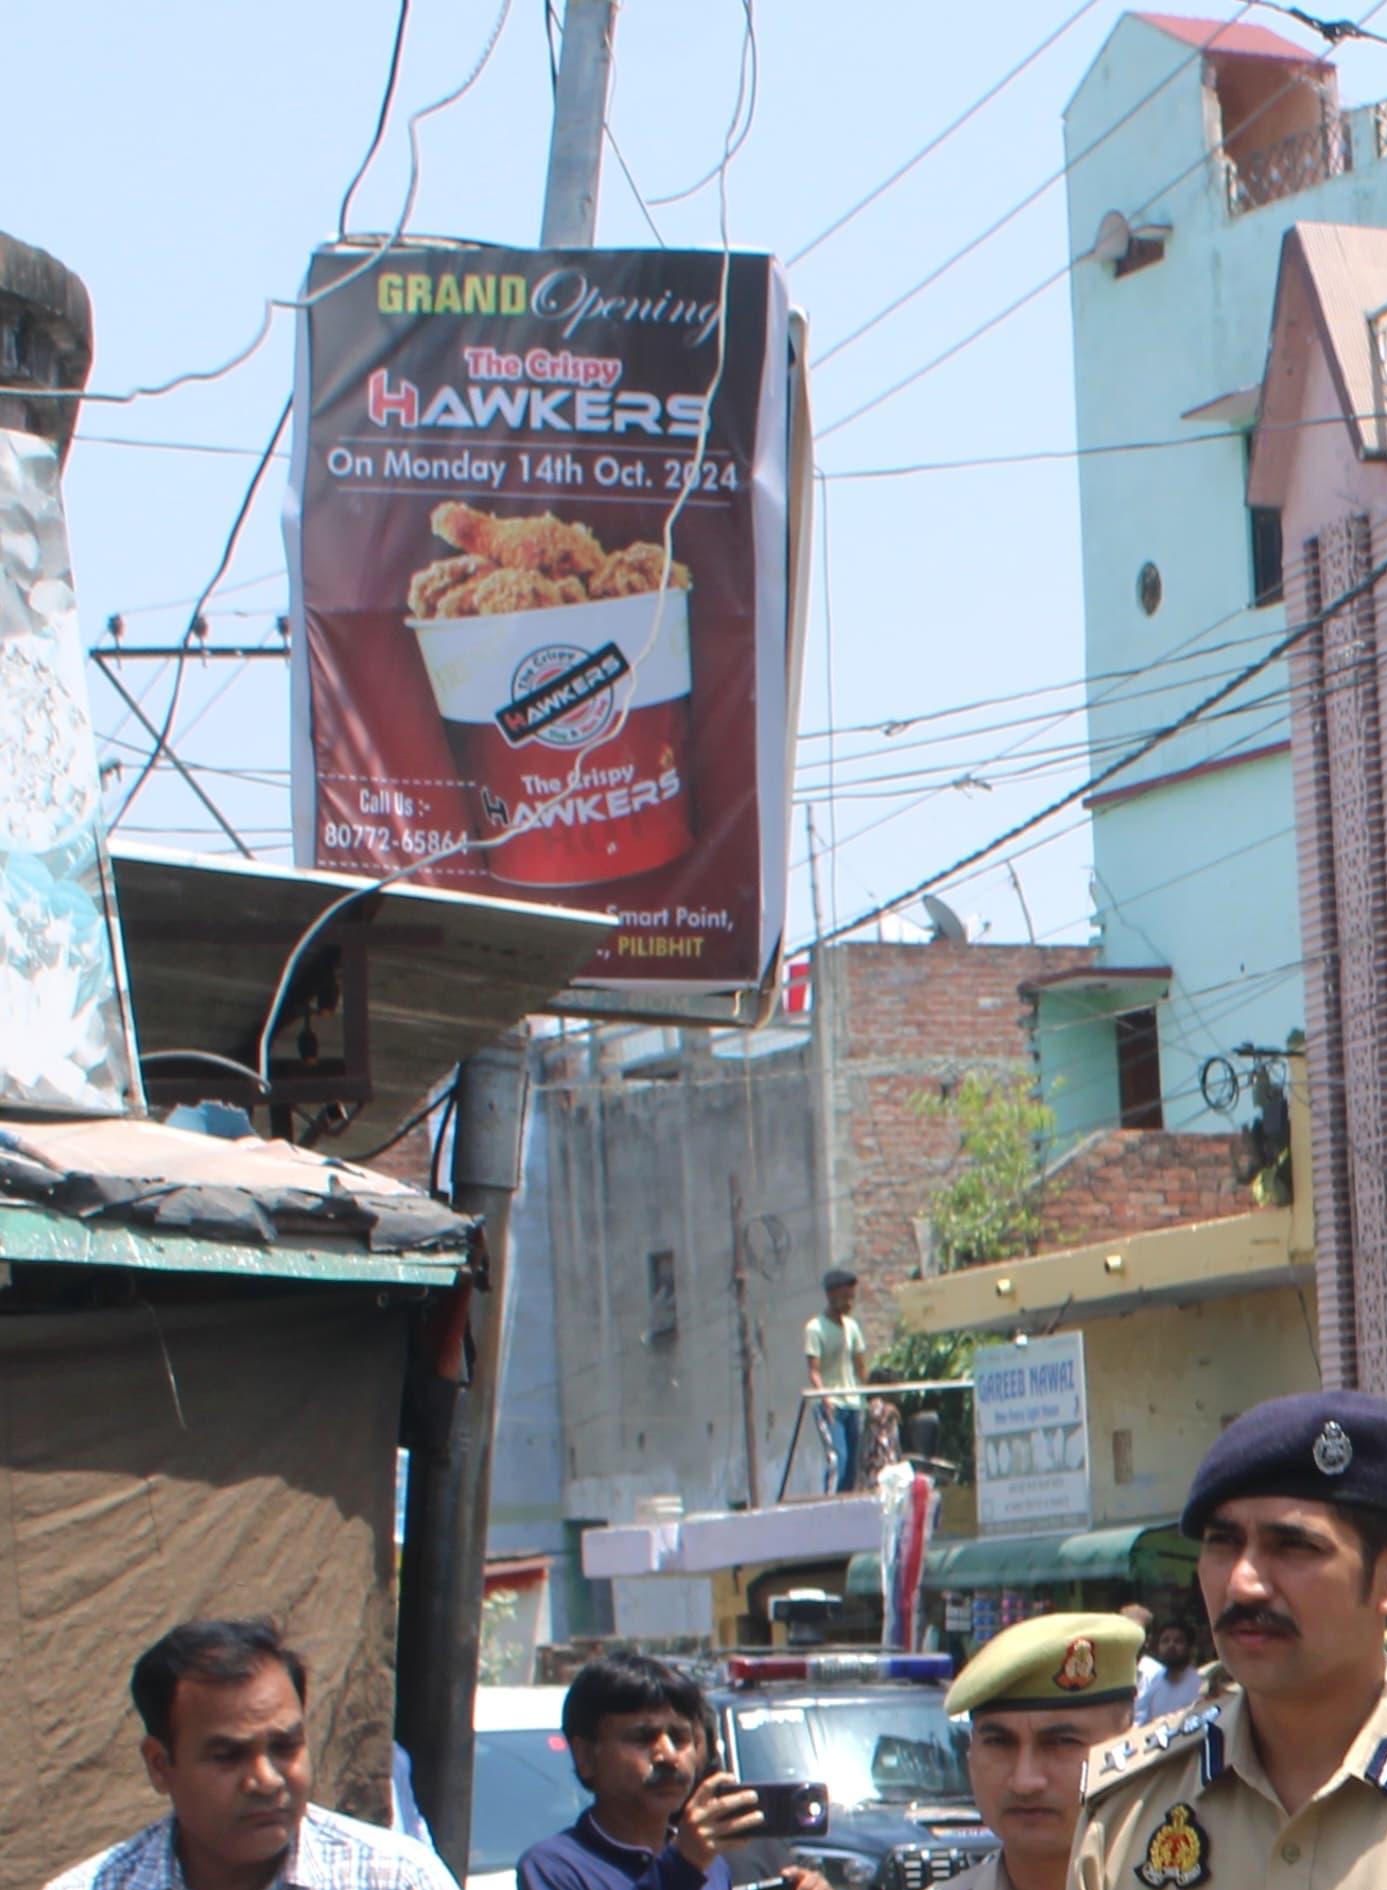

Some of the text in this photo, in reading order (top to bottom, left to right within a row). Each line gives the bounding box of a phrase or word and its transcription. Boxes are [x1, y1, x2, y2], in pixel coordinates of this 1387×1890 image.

[378, 267, 721, 348] GRAND Opening
[465, 347, 621, 388] The Crispy
[368, 367, 710, 435] HAWKERS
[327, 447, 738, 492] On Monday 14th Oct. 2024
[503, 653, 621, 731] HAWKERS
[481, 768, 681, 829] HAWKERS
[520, 764, 635, 795] The Crispy
[359, 788, 391, 814] Call
[394, 791, 413, 816] Us
[325, 822, 468, 855] 80772-65864
[676, 906, 734, 932] Point,
[618, 936, 704, 957] PILIBHIT
[978, 1359, 1075, 1403] GAREEB NAWAZ
